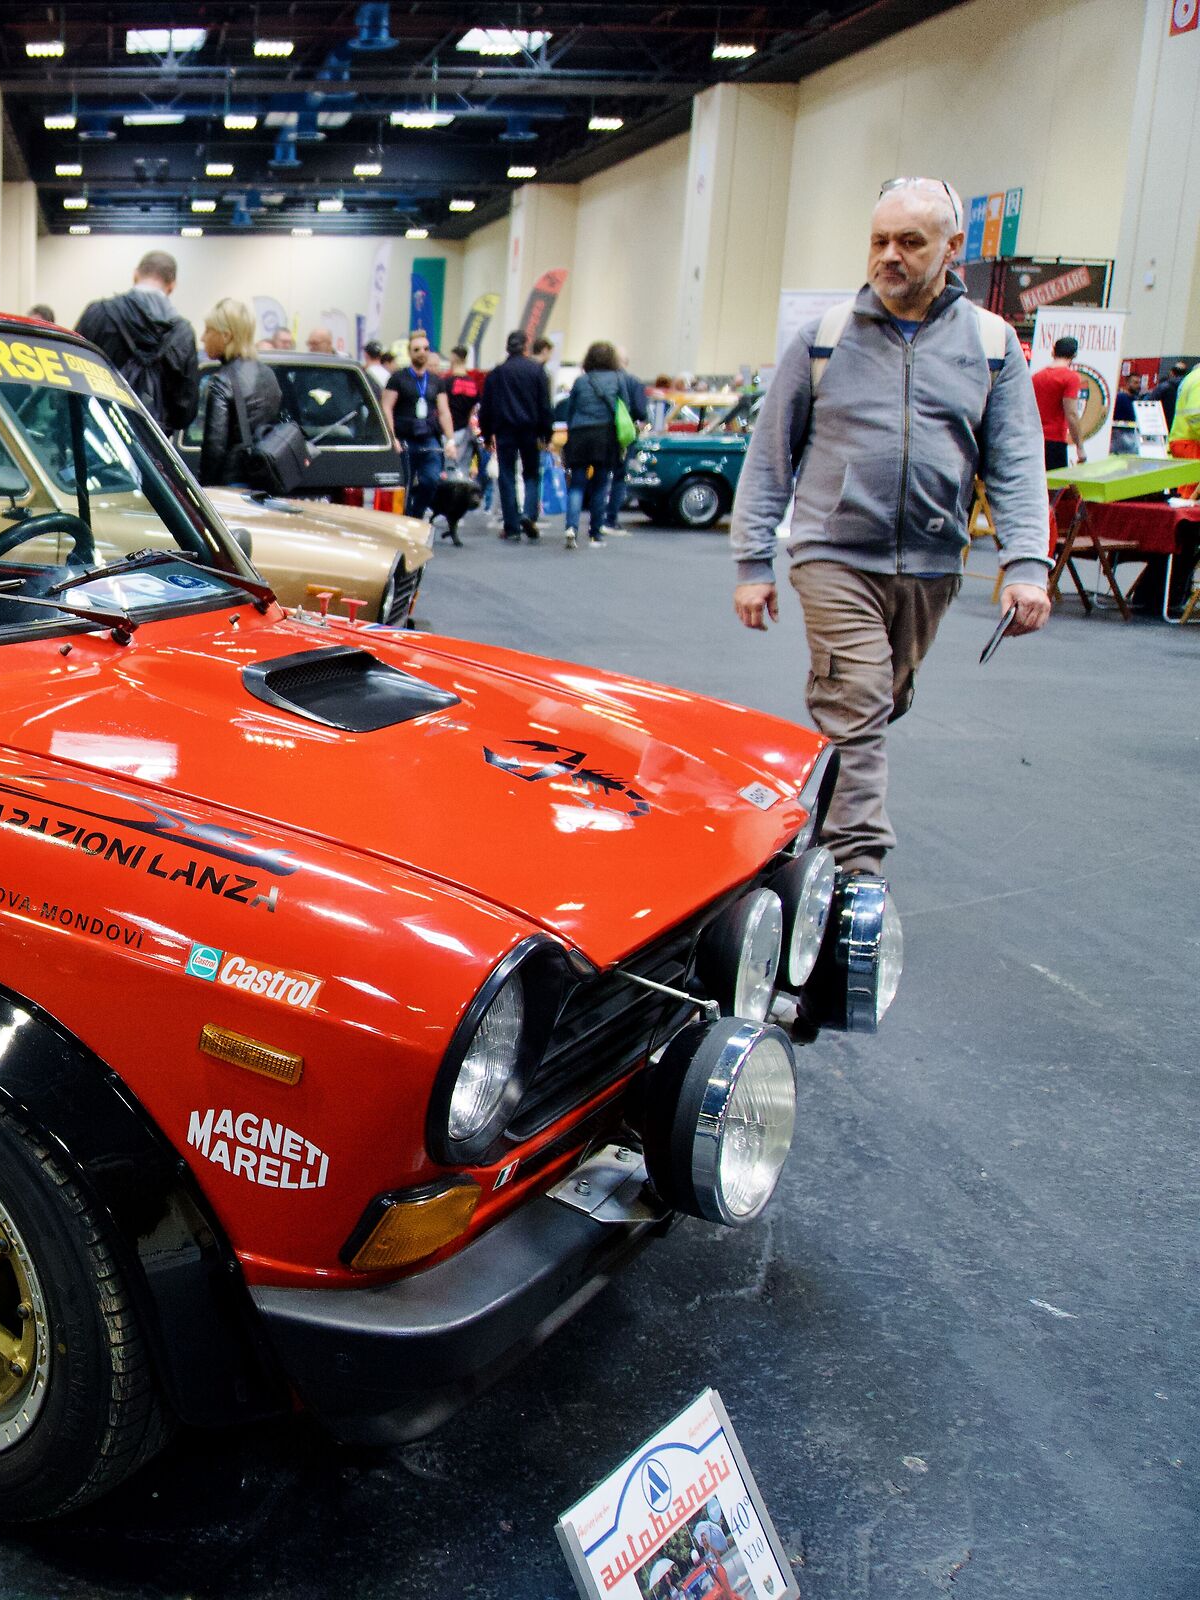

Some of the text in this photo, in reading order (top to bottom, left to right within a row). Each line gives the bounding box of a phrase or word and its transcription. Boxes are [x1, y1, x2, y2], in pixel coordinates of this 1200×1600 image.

[147, 853, 279, 914] LANZA
[194, 955, 216, 968] Castrol
[220, 956, 321, 1008] Castrol
[187, 1109, 329, 1172] MAGNETI
[601, 1454, 731, 1591] autobianchi
[743, 1536, 765, 1565] Y10
